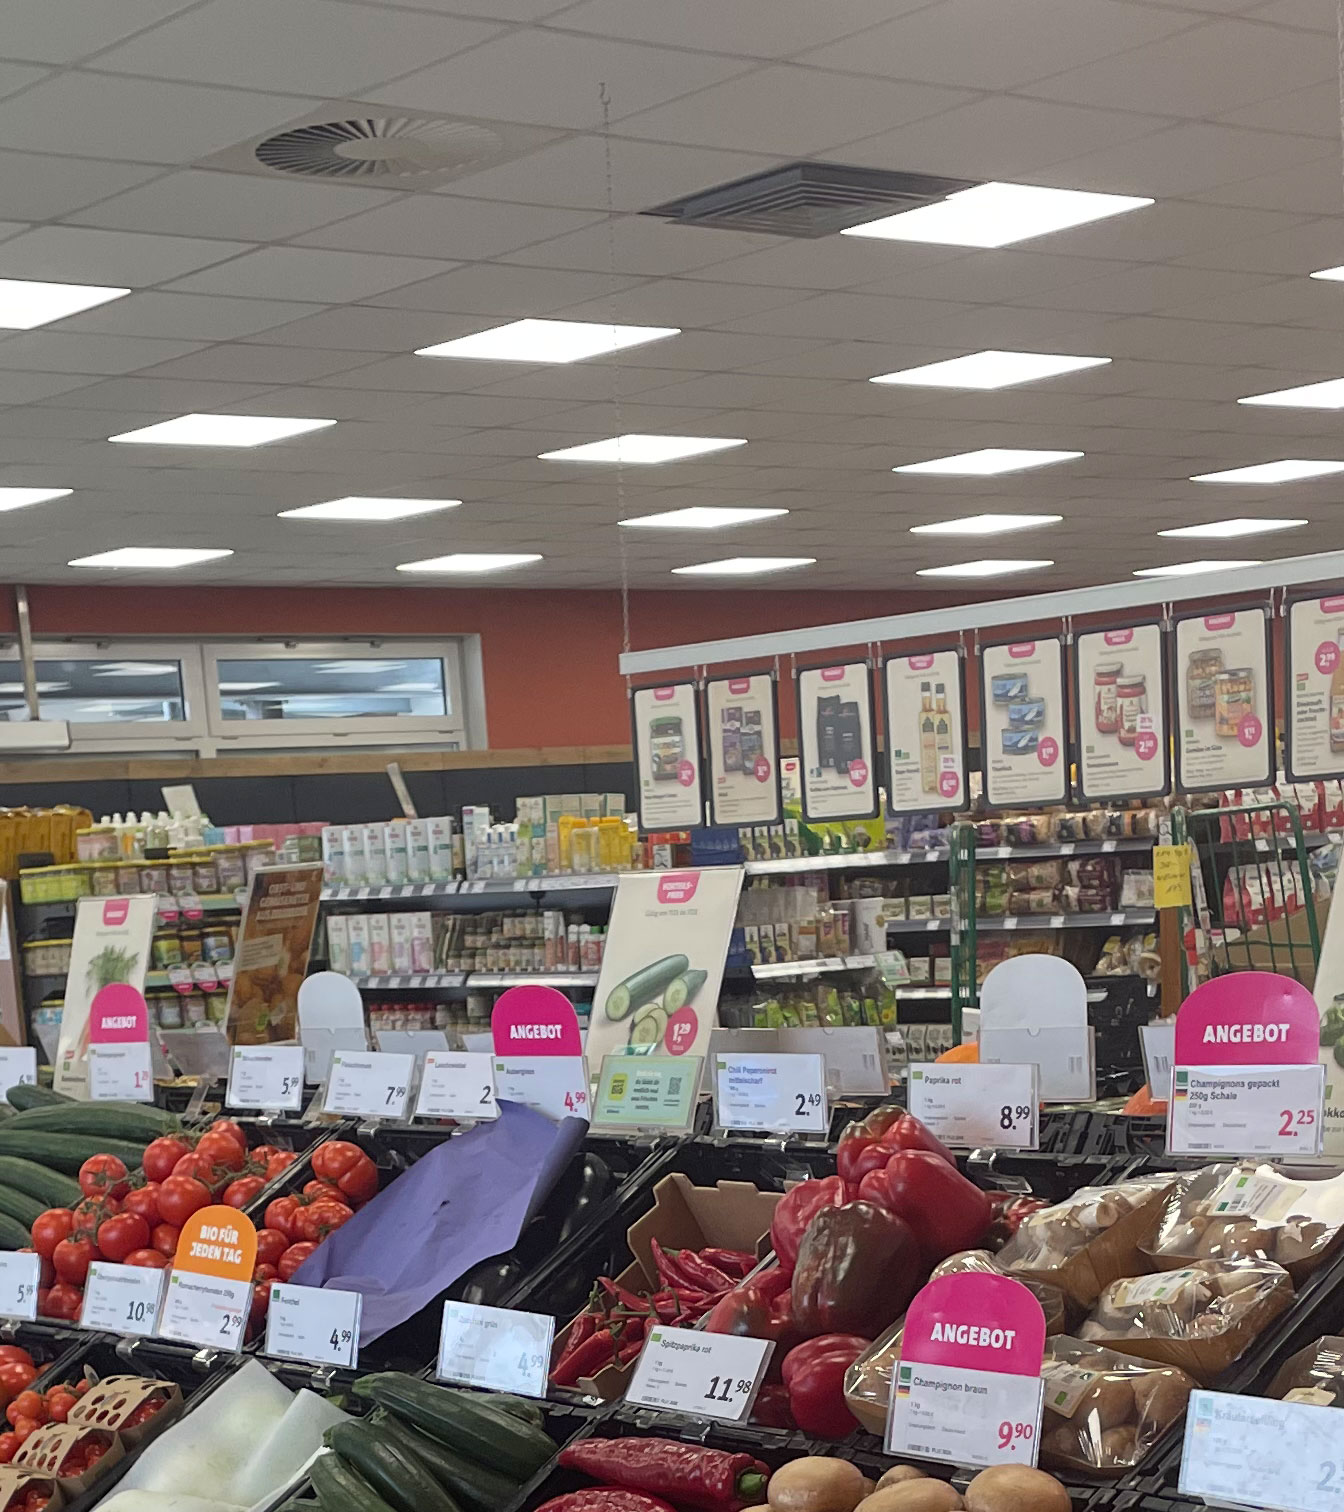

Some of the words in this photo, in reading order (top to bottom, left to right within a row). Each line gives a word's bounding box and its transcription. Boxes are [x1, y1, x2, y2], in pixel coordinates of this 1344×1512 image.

[510, 1023, 563, 1040] ANGEBOT
[1203, 1023, 1291, 1044] ANGEBOT
[924, 1076, 950, 1085] Paprika
[1190, 1079, 1245, 1091] Champignons
[1247, 1079, 1280, 1091] gepackt
[564, 1091, 586, 1113] 4.99
[795, 1093, 821, 1117] 2.49
[1189, 1092, 1208, 1102] 250g
[1210, 1091, 1237, 1100] Schale
[1000, 1105, 1030, 1131] 8.99
[1278, 1109, 1315, 1137] 2.25
[200, 1225, 217, 1241] BIO
[218, 1225, 239, 1245] FÜR
[190, 1242, 223, 1261] JEDEN
[223, 1247, 242, 1265] TAG
[329, 1328, 352, 1352] 4.99
[661, 1339, 700, 1353] Spitzpaprika
[930, 1322, 1016, 1350] ANGEBOT
[704, 1376, 753, 1403] 11.98
[913, 1376, 963, 1392] Champignon
[965, 1383, 988, 1395] braun
[997, 1421, 1033, 1451] 9.90
